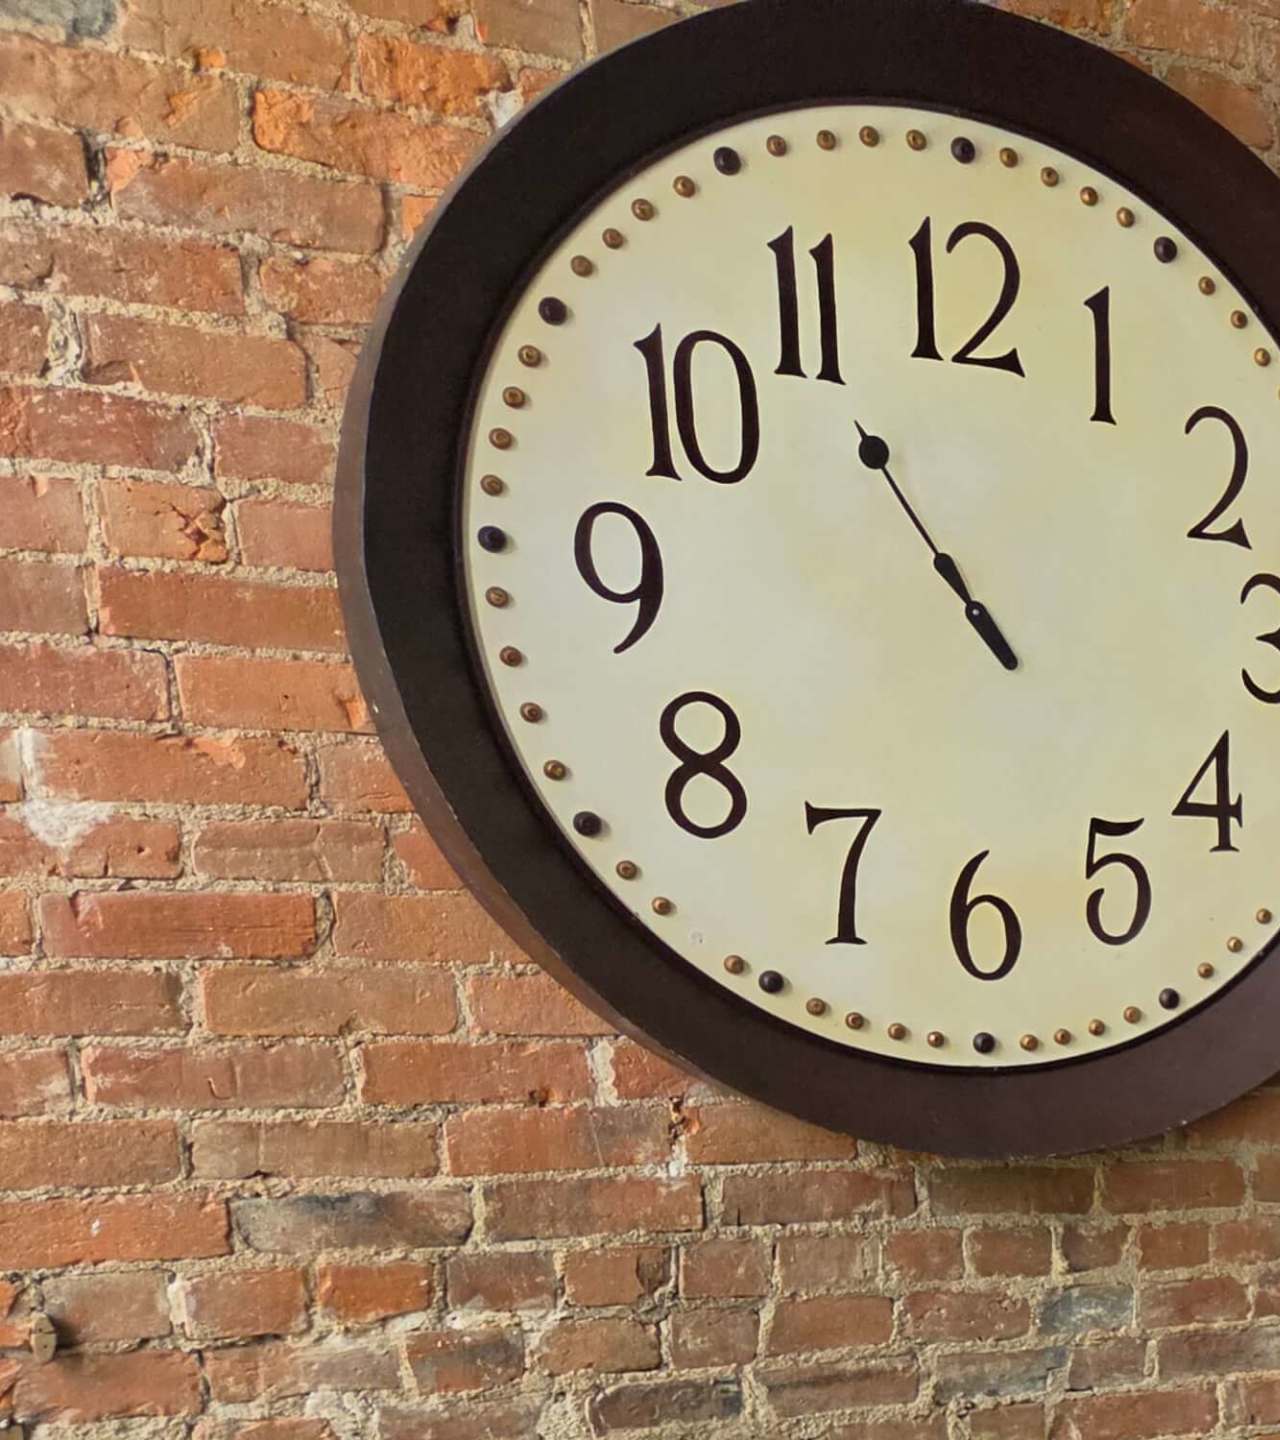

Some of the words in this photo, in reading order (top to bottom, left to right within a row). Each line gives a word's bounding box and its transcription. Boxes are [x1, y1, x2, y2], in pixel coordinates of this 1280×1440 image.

[767, 226, 846, 385] 11
[909, 216, 1025, 377] 12
[1084, 286, 1117, 425] 1
[634, 323, 760, 484] 10
[1184, 405, 1252, 549] 2
[574, 501, 664, 654] 9
[659, 691, 748, 839] 8
[1172, 730, 1243, 853] 4
[805, 802, 882, 945] 7
[949, 850, 1022, 981] 6
[1085, 818, 1152, 945] 5
